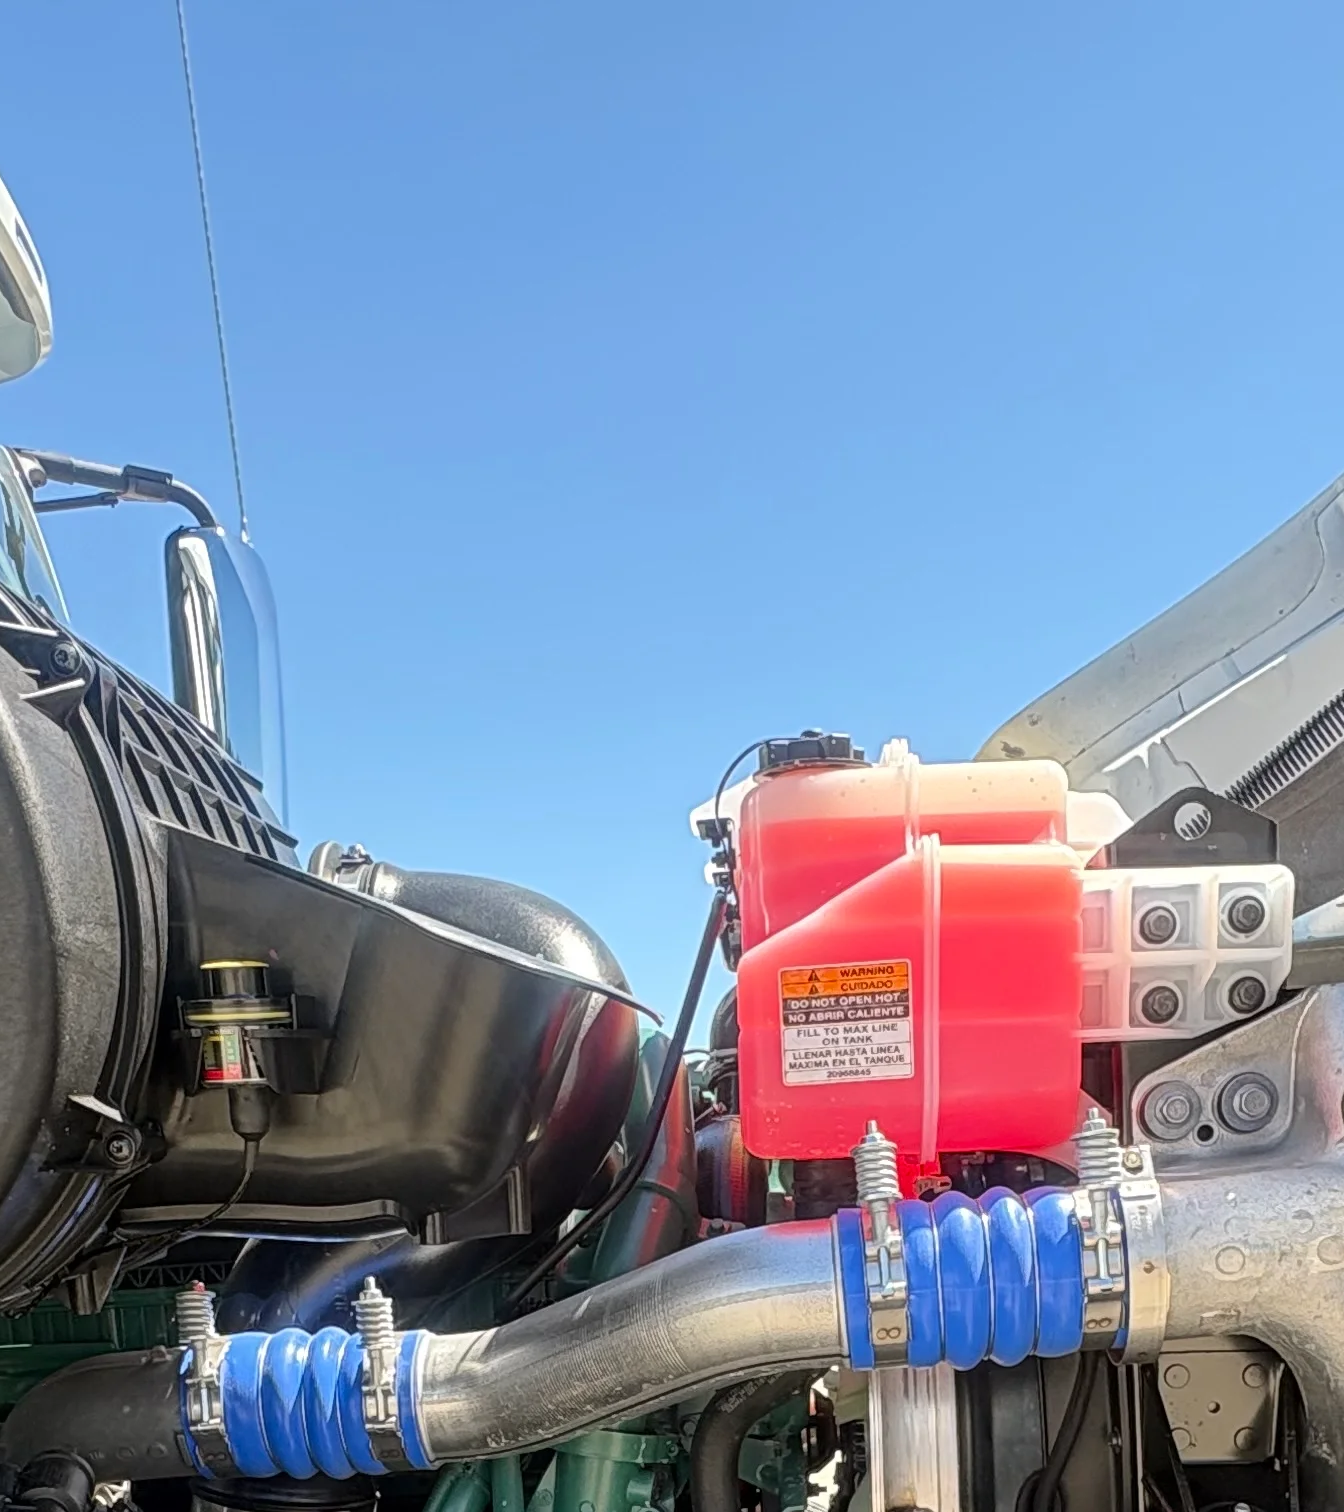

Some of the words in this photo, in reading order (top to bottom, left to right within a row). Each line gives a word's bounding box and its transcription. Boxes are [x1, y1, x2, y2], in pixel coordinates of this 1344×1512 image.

[840, 965, 895, 978] WARNING
[840, 979, 893, 992] CUIDADO
[791, 999, 809, 1009] DO
[811, 997, 837, 1008] NOT
[839, 995, 872, 1006] OPEN
[875, 992, 900, 1004] HOT
[788, 1013, 805, 1023] NO
[808, 1010, 845, 1022] ABRIR
[847, 1006, 904, 1019] CALIENTE
[797, 1029, 821, 1038] FILL
[824, 1027, 839, 1036] TO
[843, 1025, 869, 1035] MAX
[872, 1023, 898, 1033] LINE
[822, 1038, 839, 1046] ON
[843, 1036, 873, 1045] TANK
[792, 1050, 832, 1060] LLENAR
[835, 1048, 868, 1058] HASTA
[870, 1045, 900, 1055] LINEA
[789, 1060, 829, 1070] MAXIMA
[832, 1059, 847, 1068] EN
[849, 1058, 861, 1066] EL
[864, 1055, 905, 1065] TANQUE
